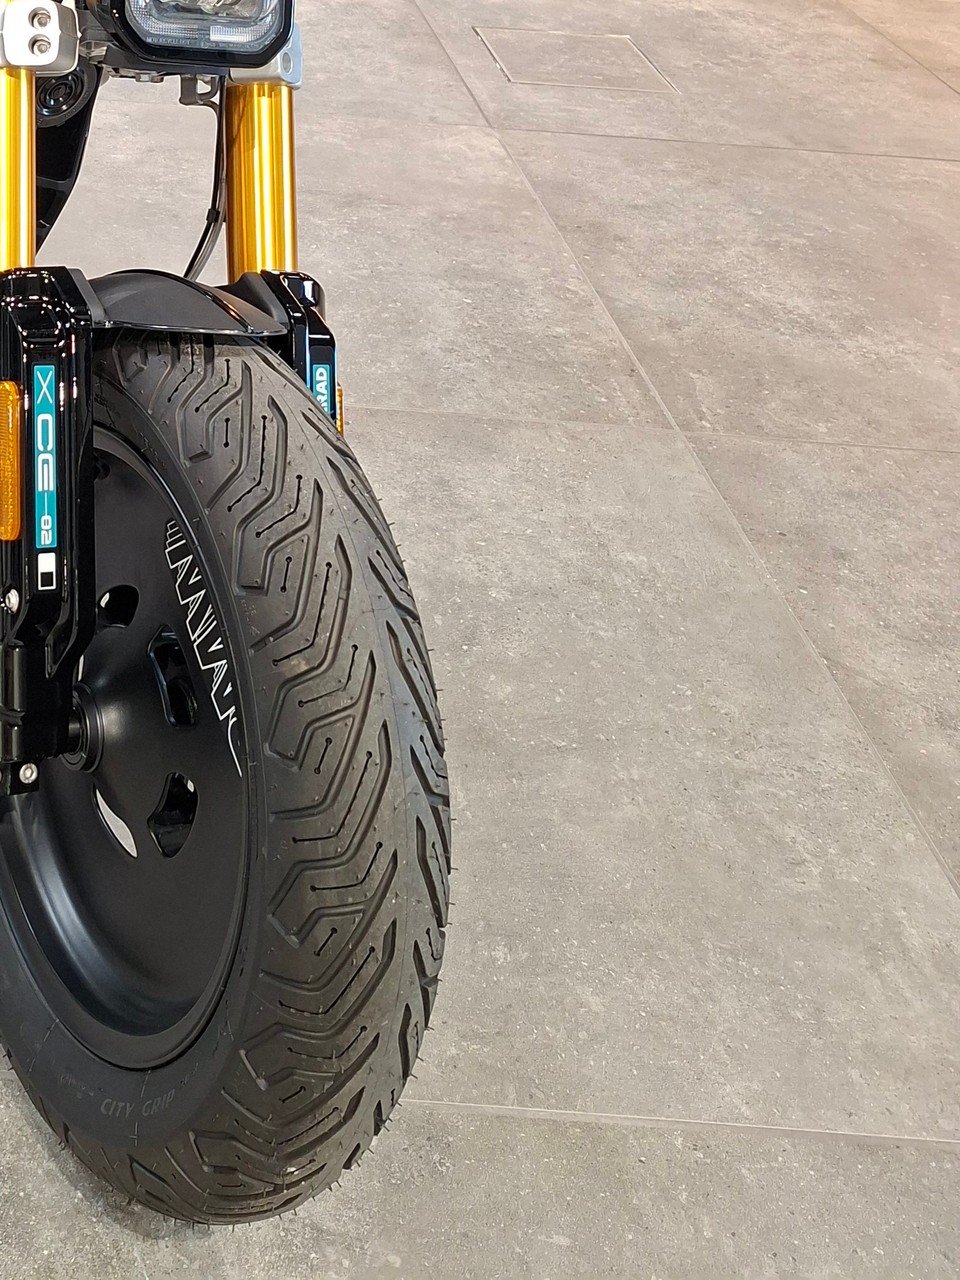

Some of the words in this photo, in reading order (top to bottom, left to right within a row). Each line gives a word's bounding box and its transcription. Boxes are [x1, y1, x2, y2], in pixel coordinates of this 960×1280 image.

[315, 367, 328, 412] RAD
[100, 1098, 135, 1118] CITY
[142, 1088, 176, 1117] GRIP
